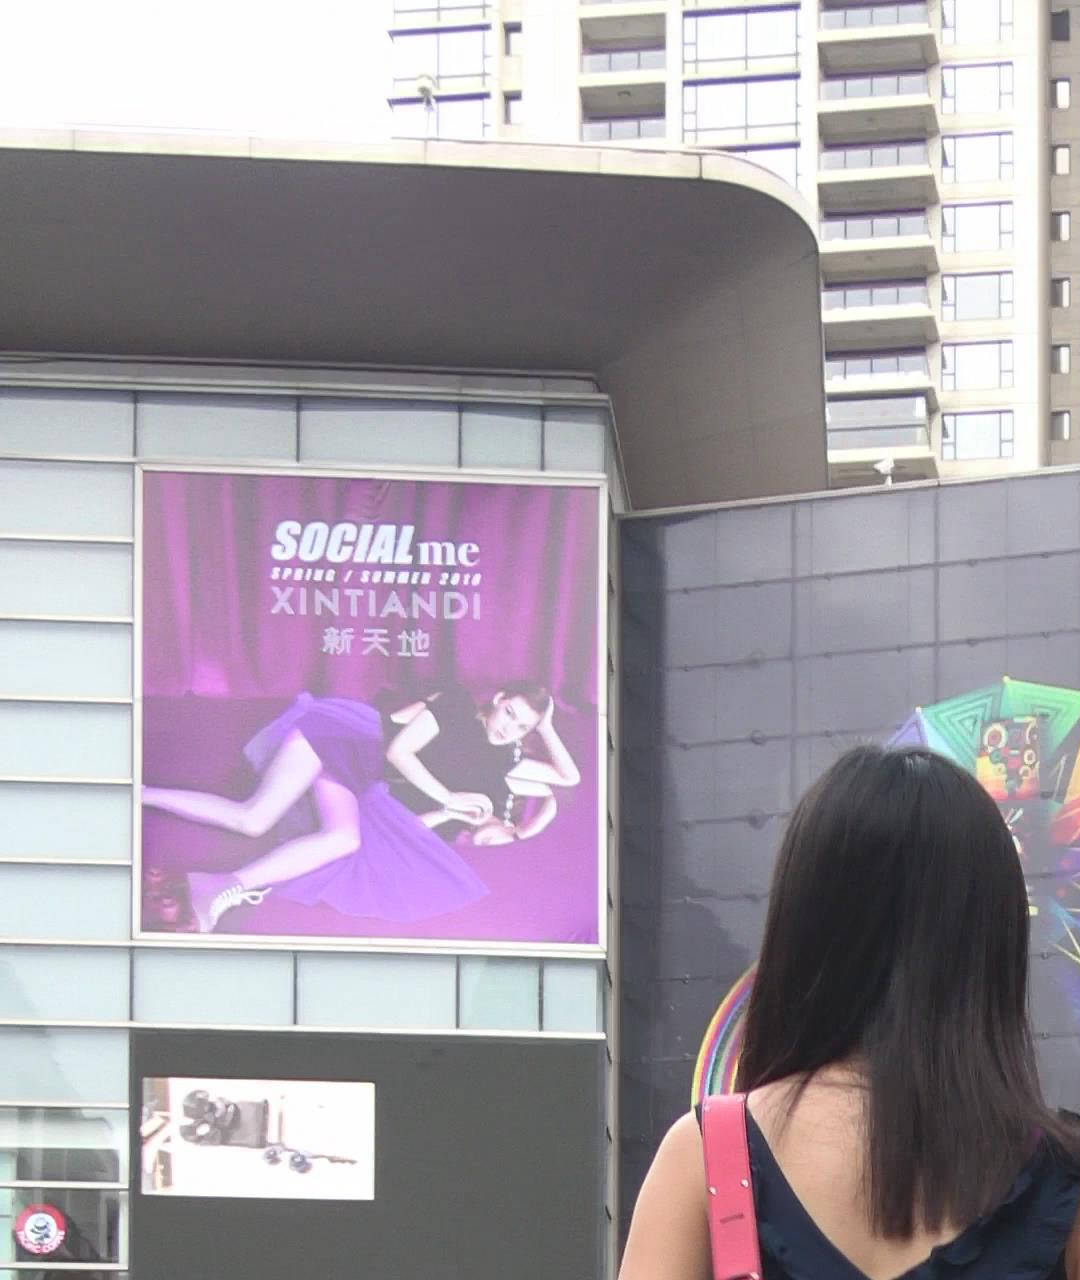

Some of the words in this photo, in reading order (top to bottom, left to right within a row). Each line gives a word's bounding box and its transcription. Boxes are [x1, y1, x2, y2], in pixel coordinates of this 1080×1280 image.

[271, 520, 415, 565] SOCIAL
[417, 540, 480, 567] me
[270, 567, 336, 582] SPRING
[360, 570, 431, 584] SUMMER
[270, 586, 481, 621] XINTIANDI
[322, 626, 431, 657] 新天地
